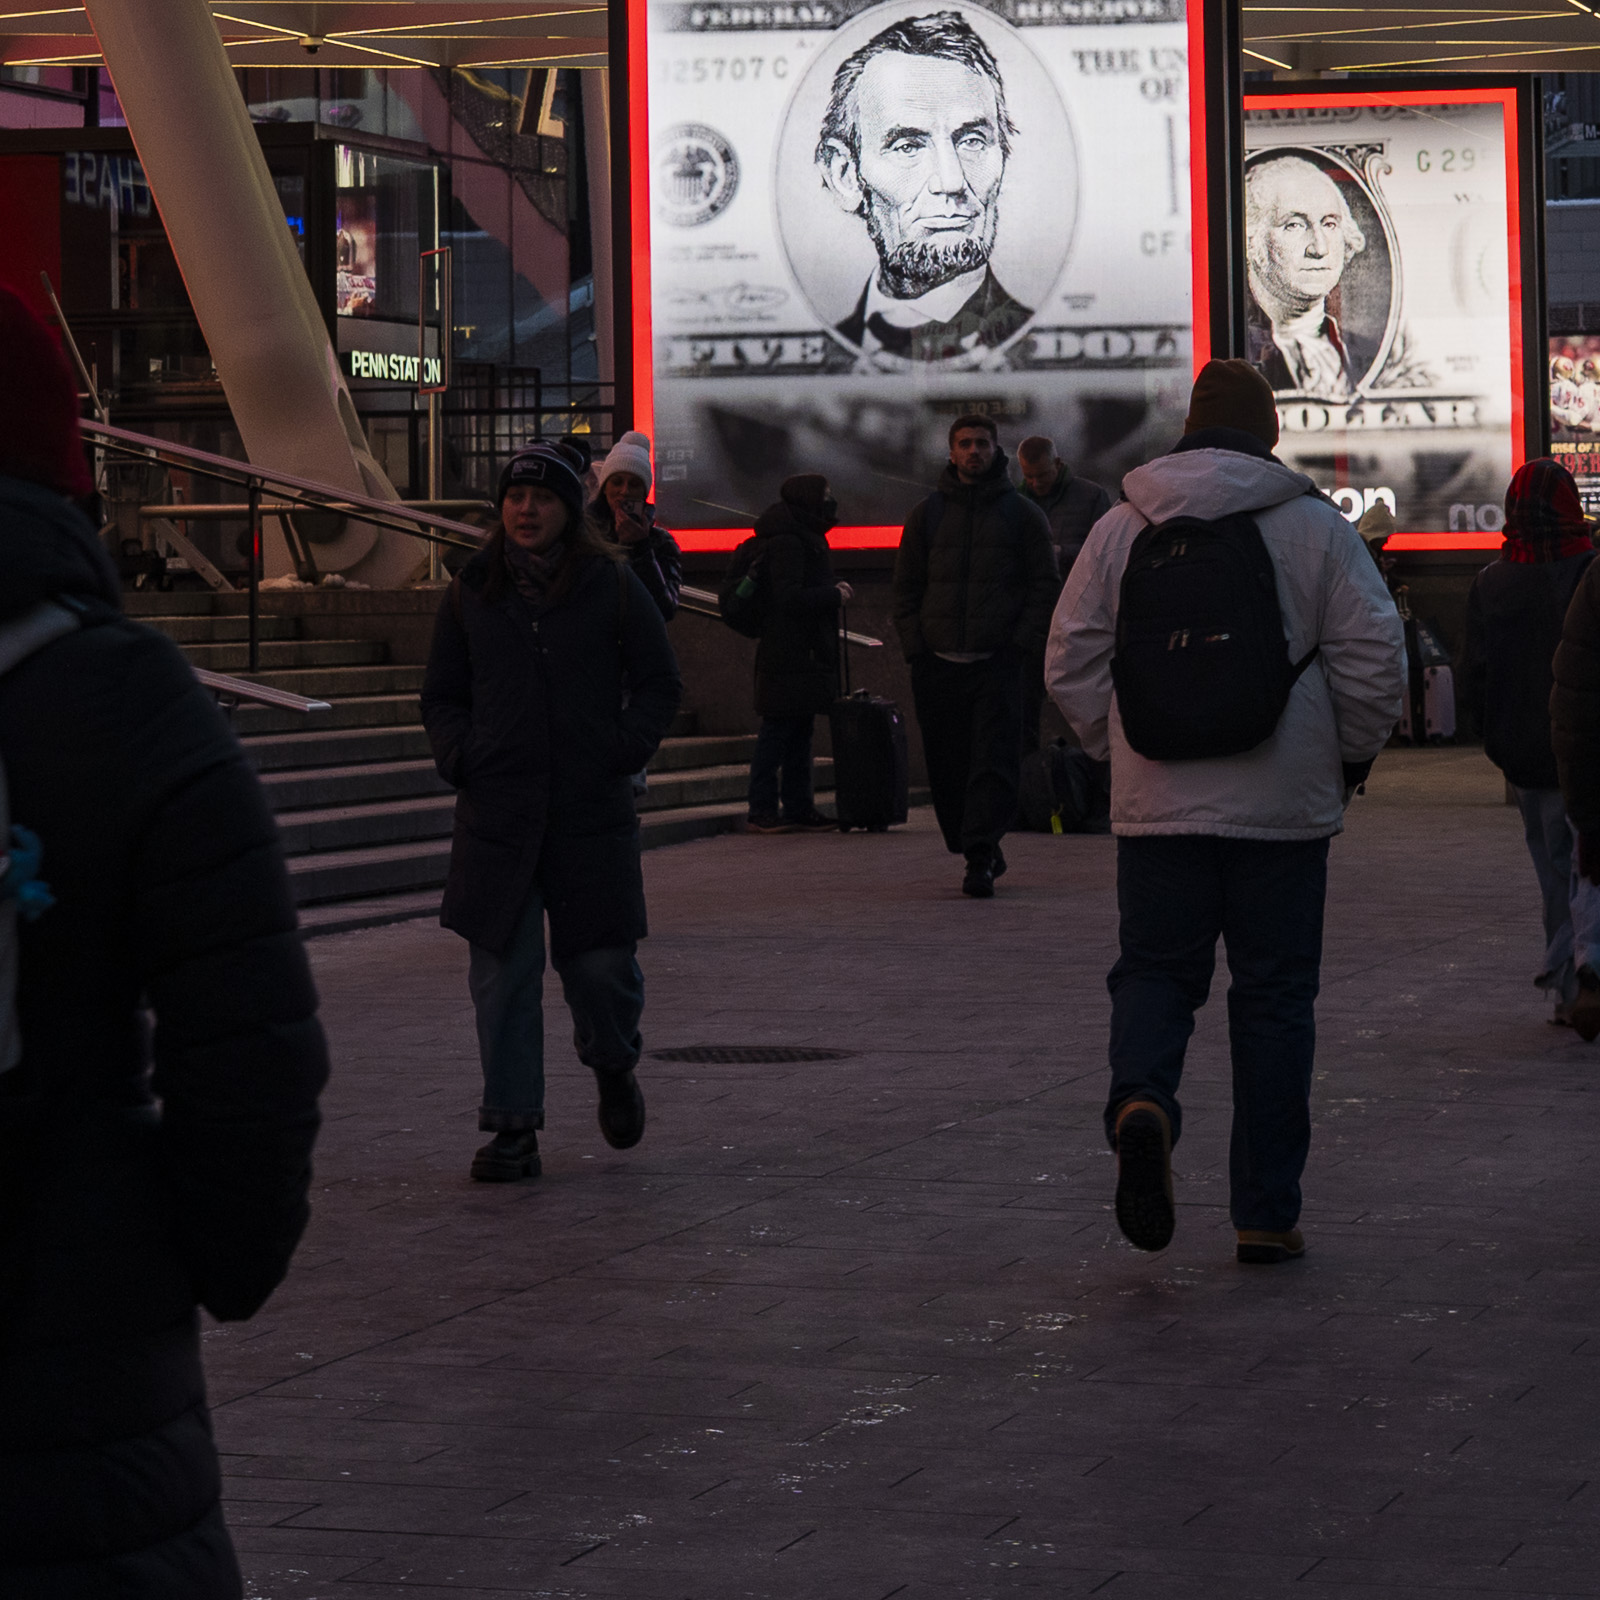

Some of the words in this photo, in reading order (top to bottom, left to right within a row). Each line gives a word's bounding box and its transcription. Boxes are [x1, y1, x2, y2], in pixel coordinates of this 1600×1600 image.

[1072, 50, 1139, 75] THE
[351, 350, 389, 380] PENN
[390, 353, 441, 385] STATON
[1279, 403, 1479, 432] OLLAR
[1577, 442, 1593, 453] OF
